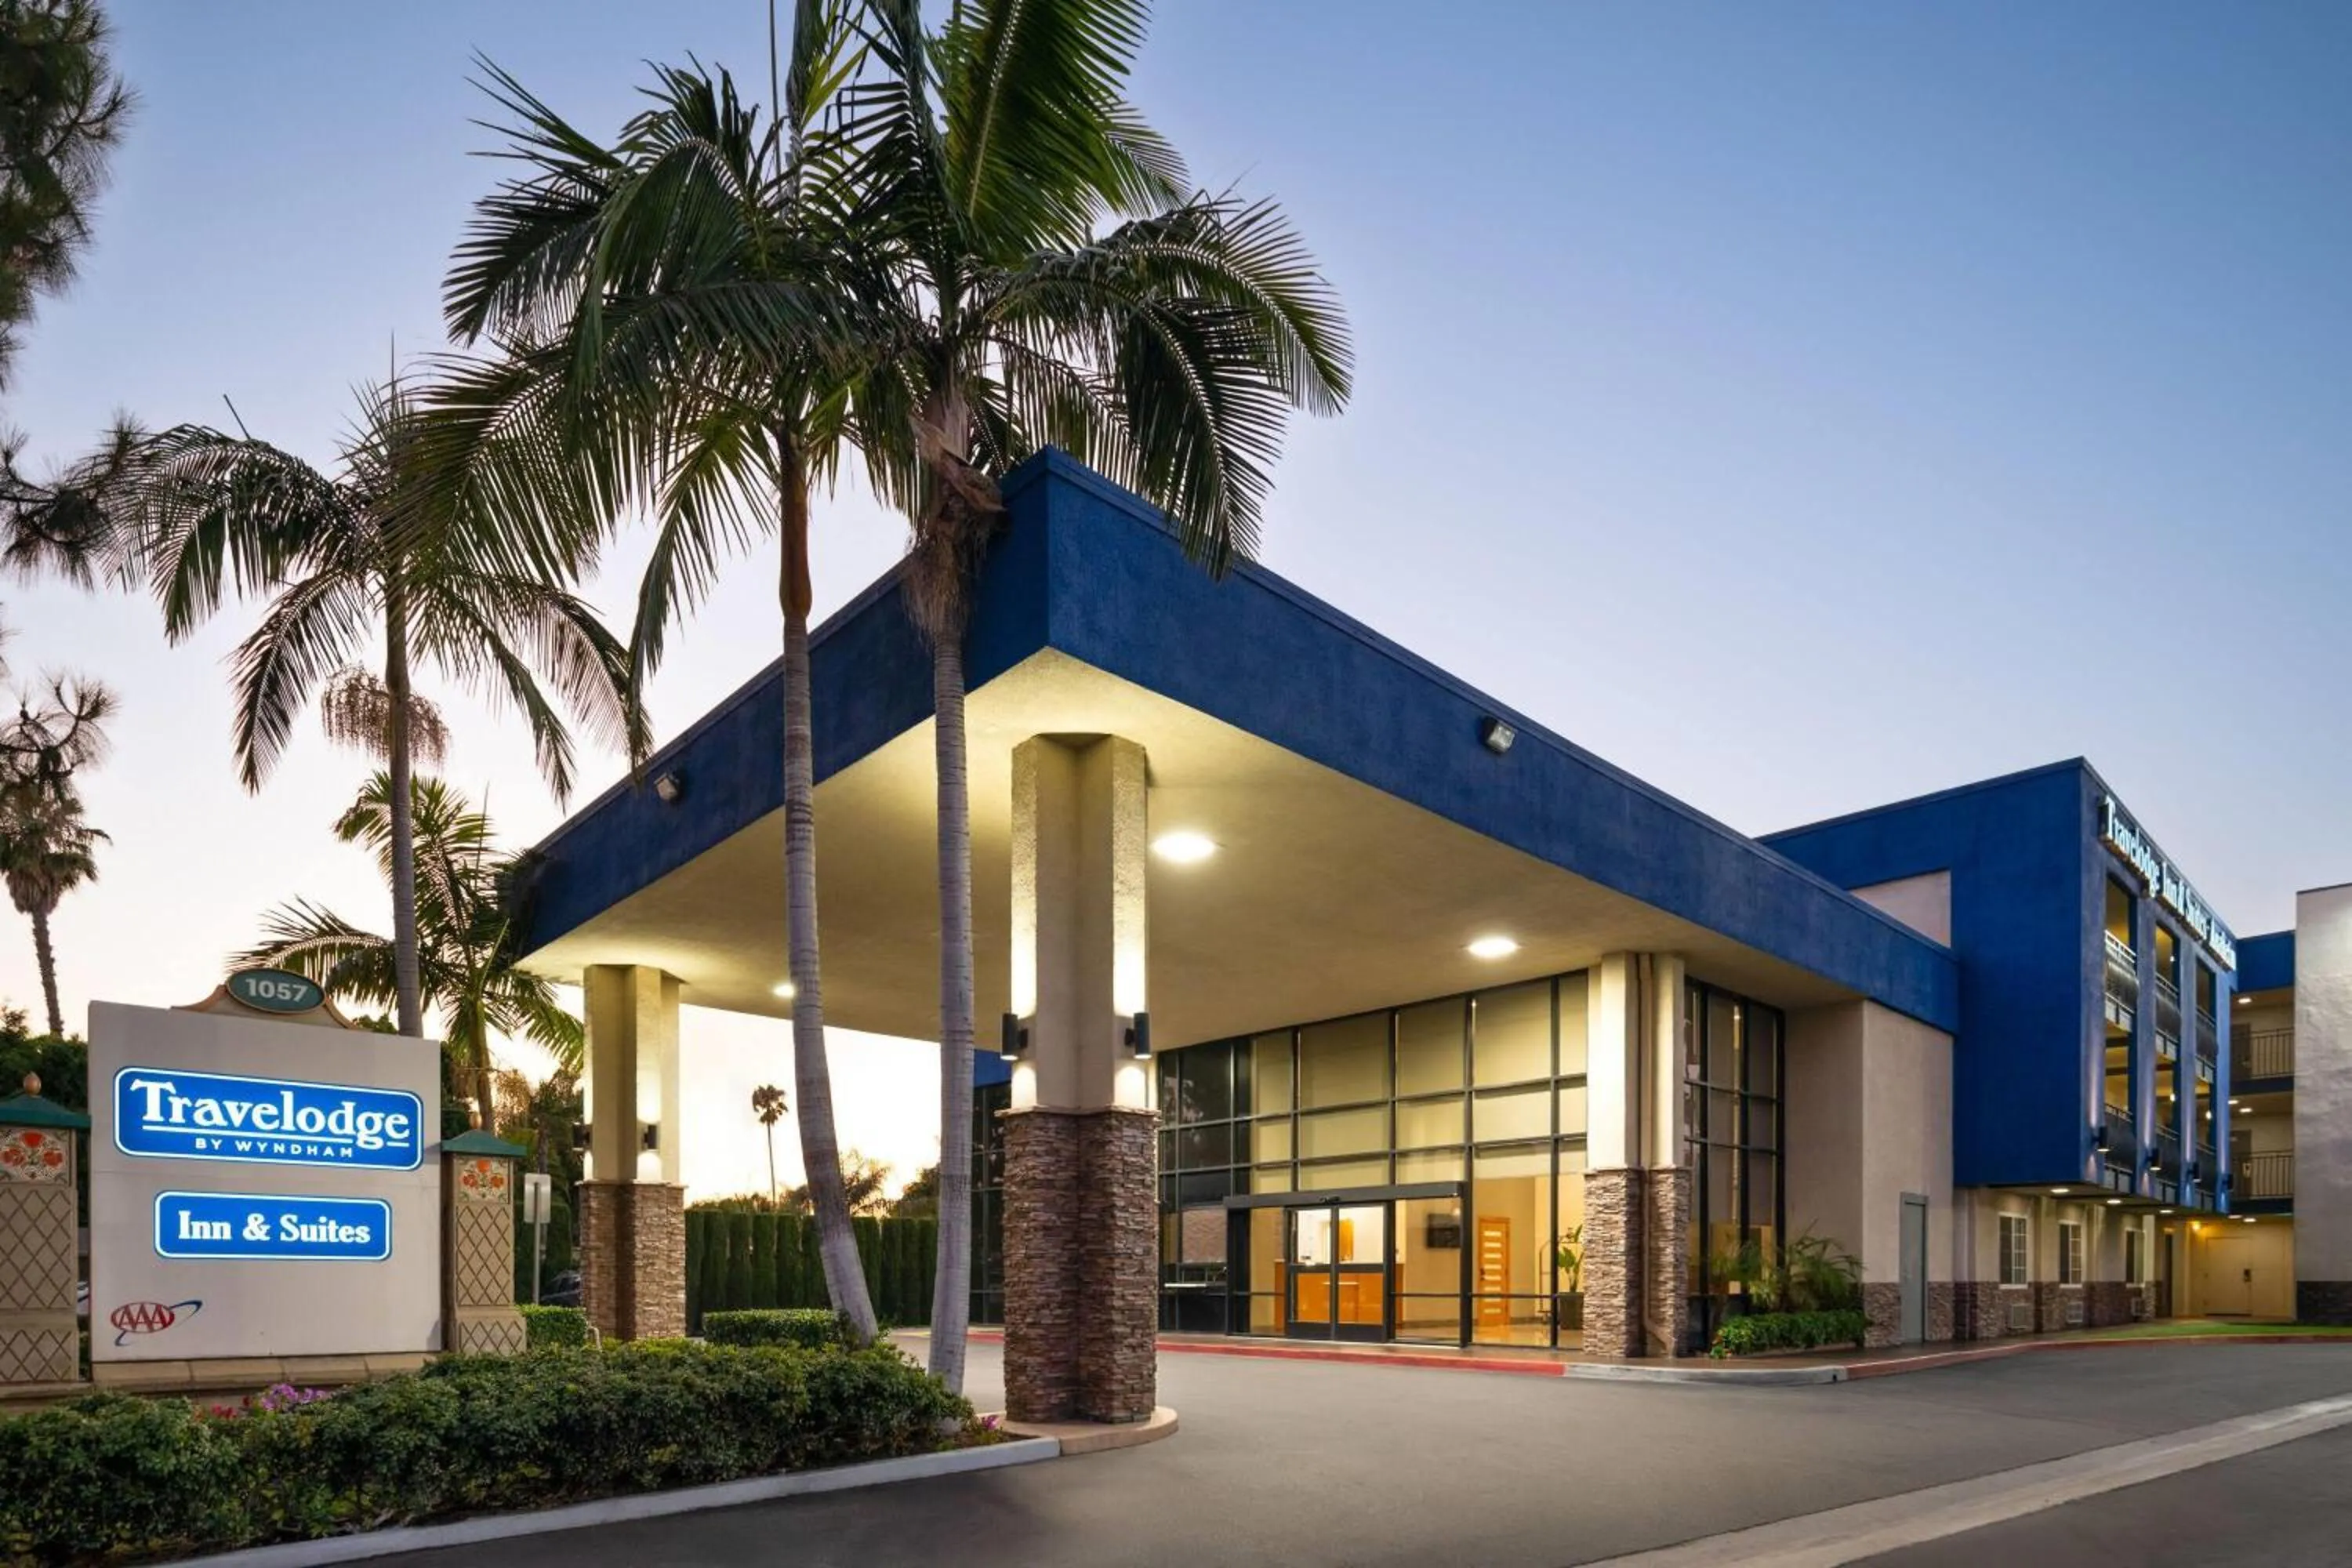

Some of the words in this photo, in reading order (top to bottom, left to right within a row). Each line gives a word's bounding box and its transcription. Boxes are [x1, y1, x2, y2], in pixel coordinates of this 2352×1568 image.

[245, 978, 308, 1003] 1057
[129, 1078, 410, 1150] Travelodge
[195, 1138, 223, 1150] BY
[237, 1140, 353, 1158] WYNDHAM
[178, 1210, 232, 1240] Inn
[242, 1213, 270, 1242] &
[280, 1214, 371, 1243] Suites
[118, 1301, 169, 1333] AAA
